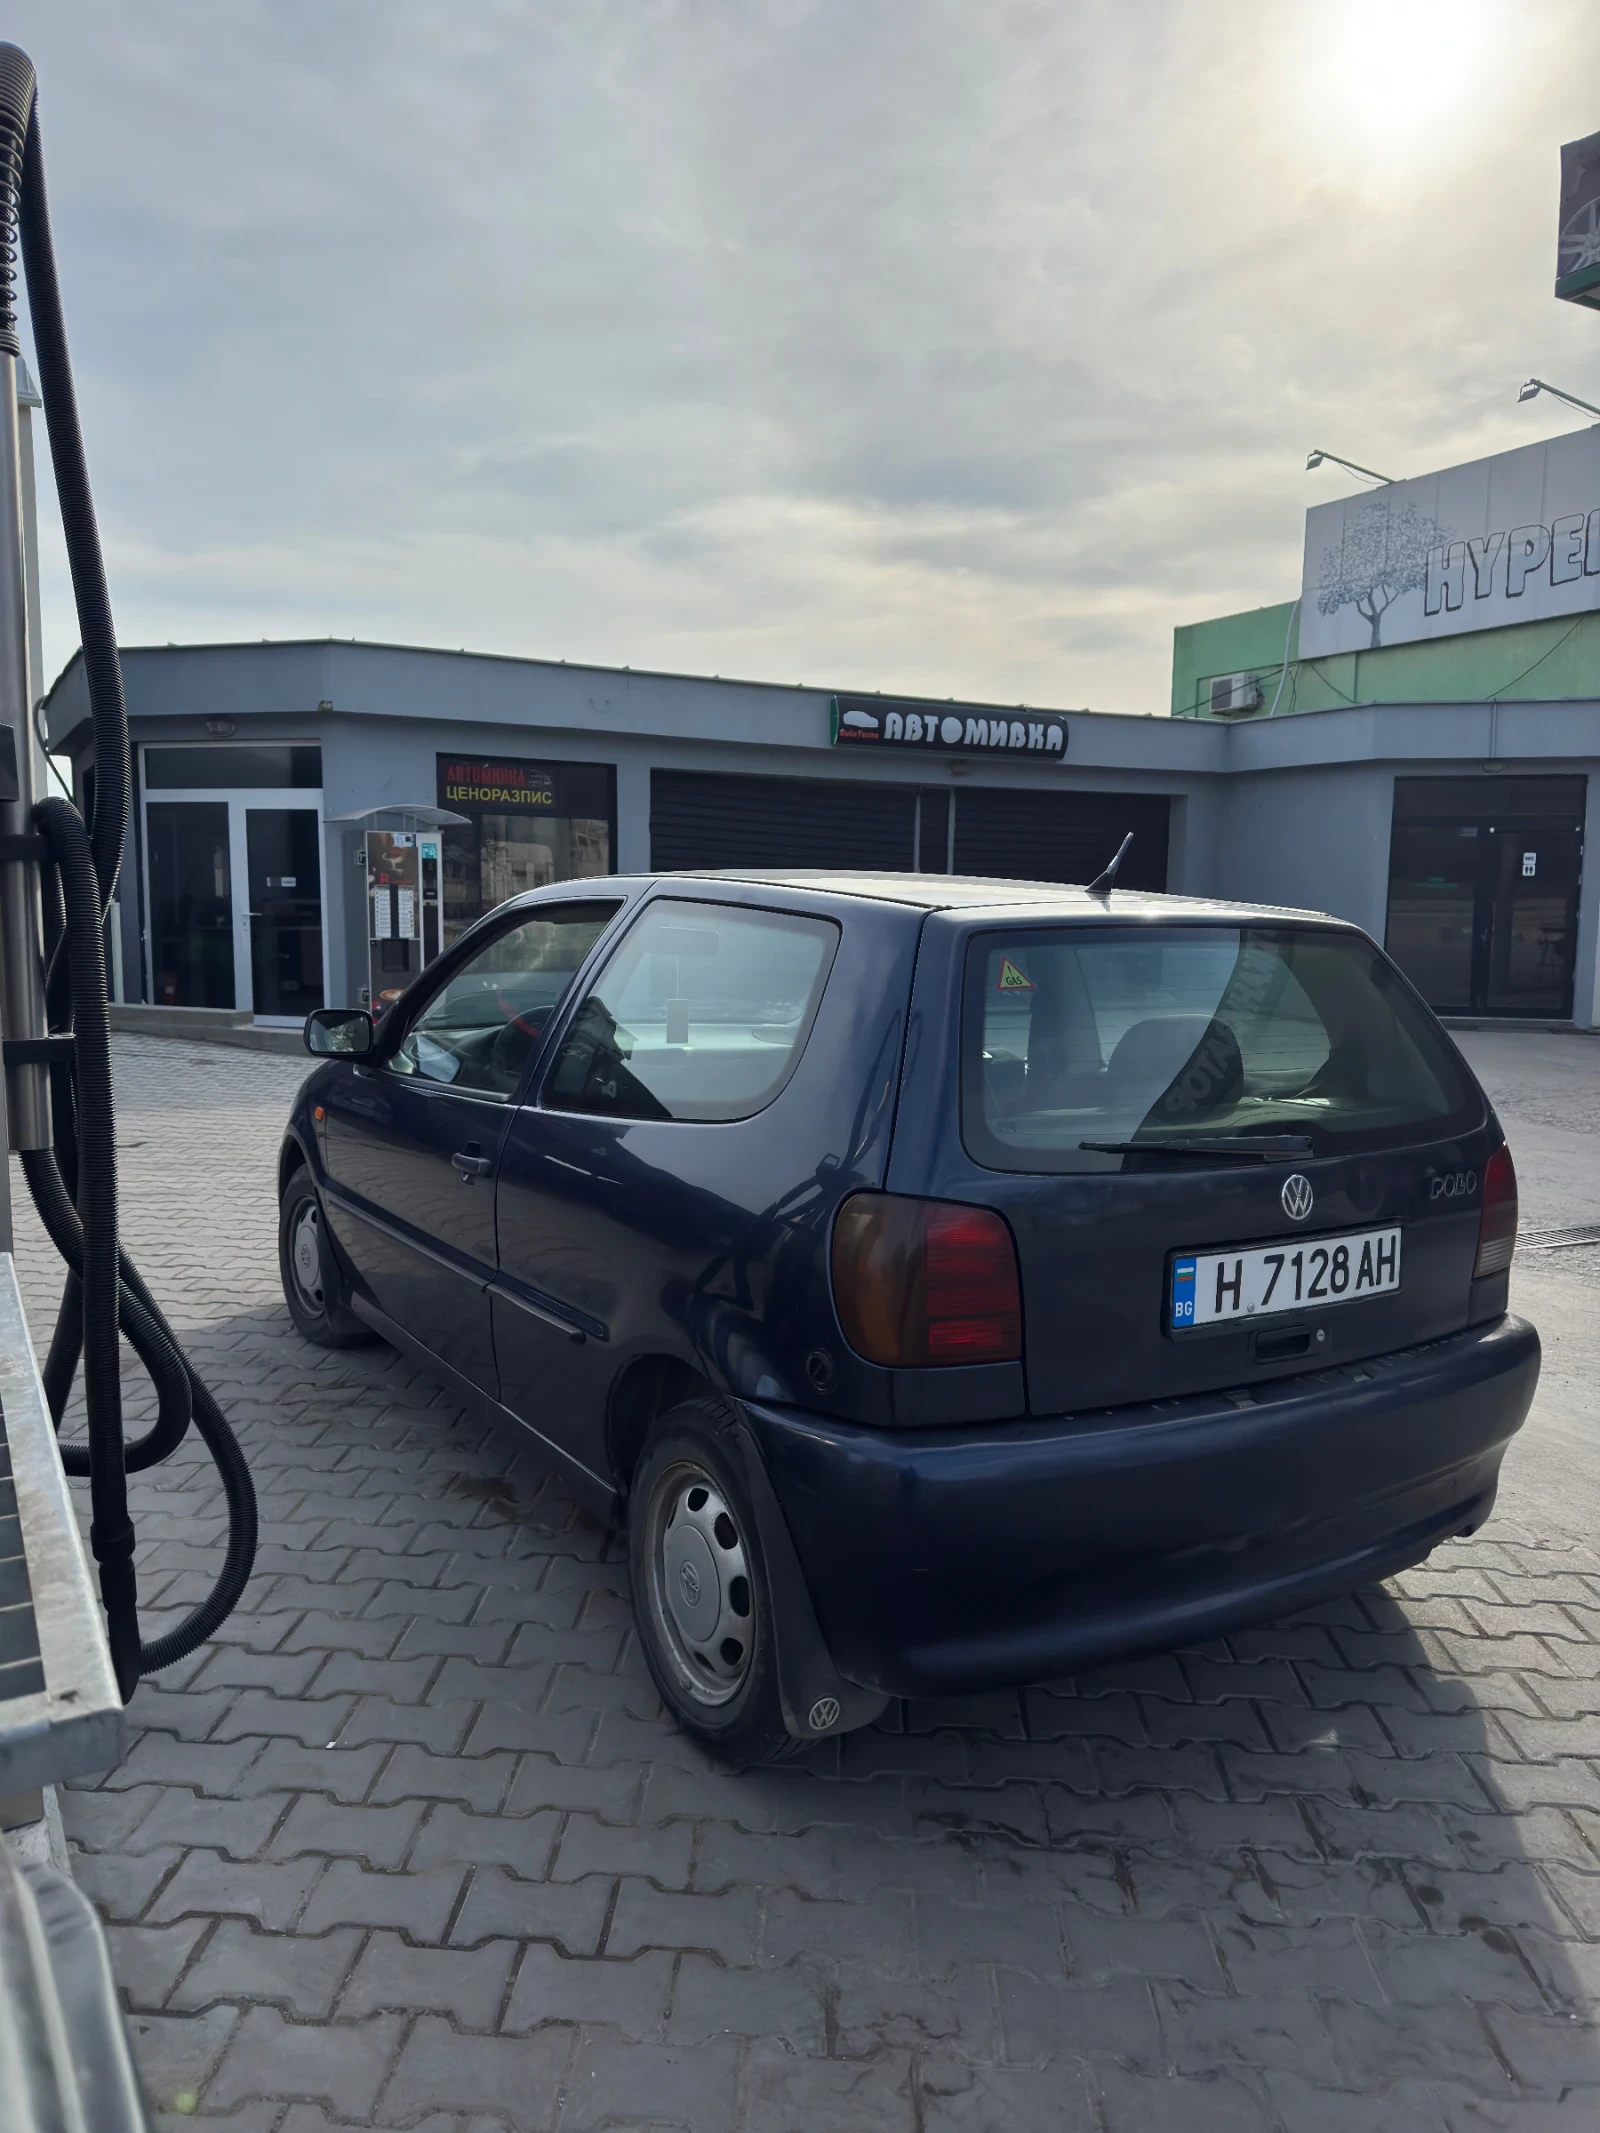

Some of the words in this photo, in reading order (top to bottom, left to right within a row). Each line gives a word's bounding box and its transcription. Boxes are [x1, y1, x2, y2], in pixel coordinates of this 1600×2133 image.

[884, 712, 1064, 751] АВТОМИВКА
[446, 785, 553, 805] ЦЕНОРАЗПИС
[1005, 976, 1023, 986] GAS
[1431, 1169, 1477, 1200] POLO
[1261, 1245, 1349, 1306] 7128
[1175, 1301, 1193, 1318] BG
